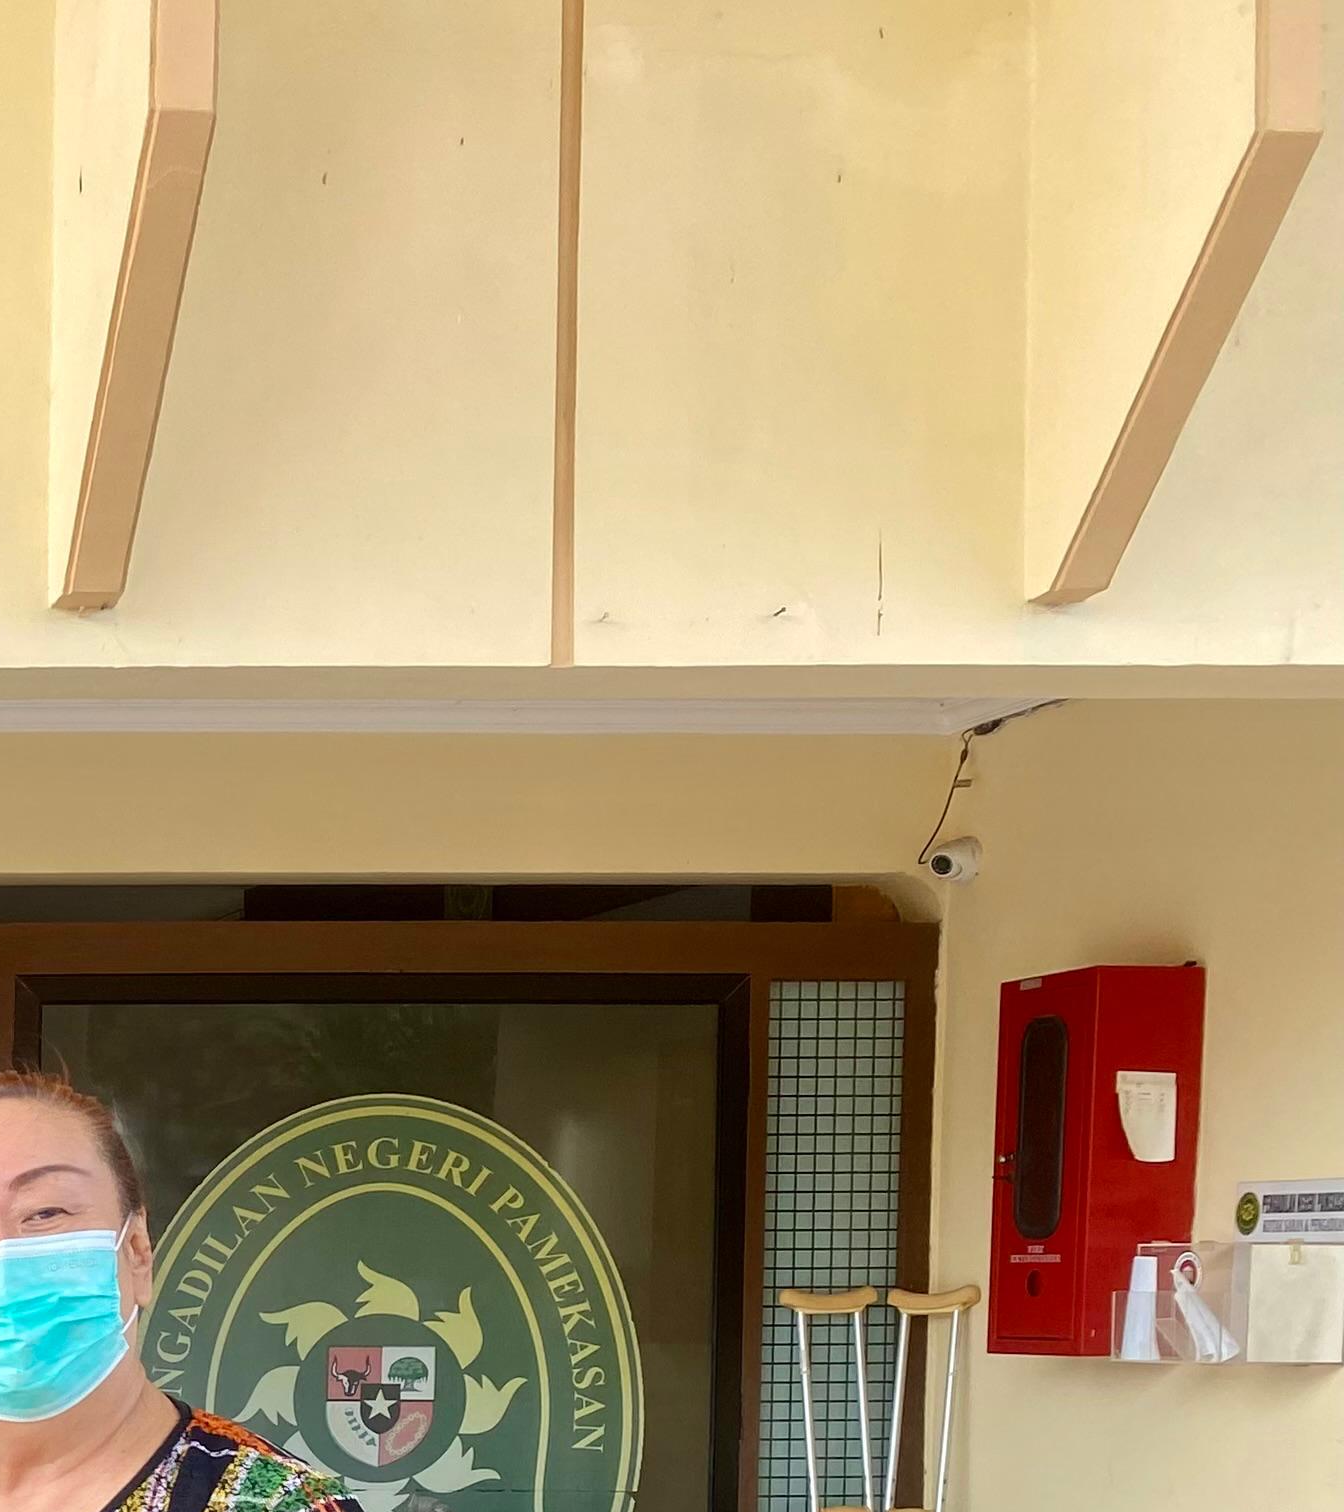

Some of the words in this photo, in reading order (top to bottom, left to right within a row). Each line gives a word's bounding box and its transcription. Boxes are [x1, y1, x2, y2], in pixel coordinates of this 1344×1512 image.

[151, 1172, 291, 1397] NGADILAN
[294, 1137, 494, 1196] NEGERI
[489, 1184, 606, 1453] PAMEKASAN
